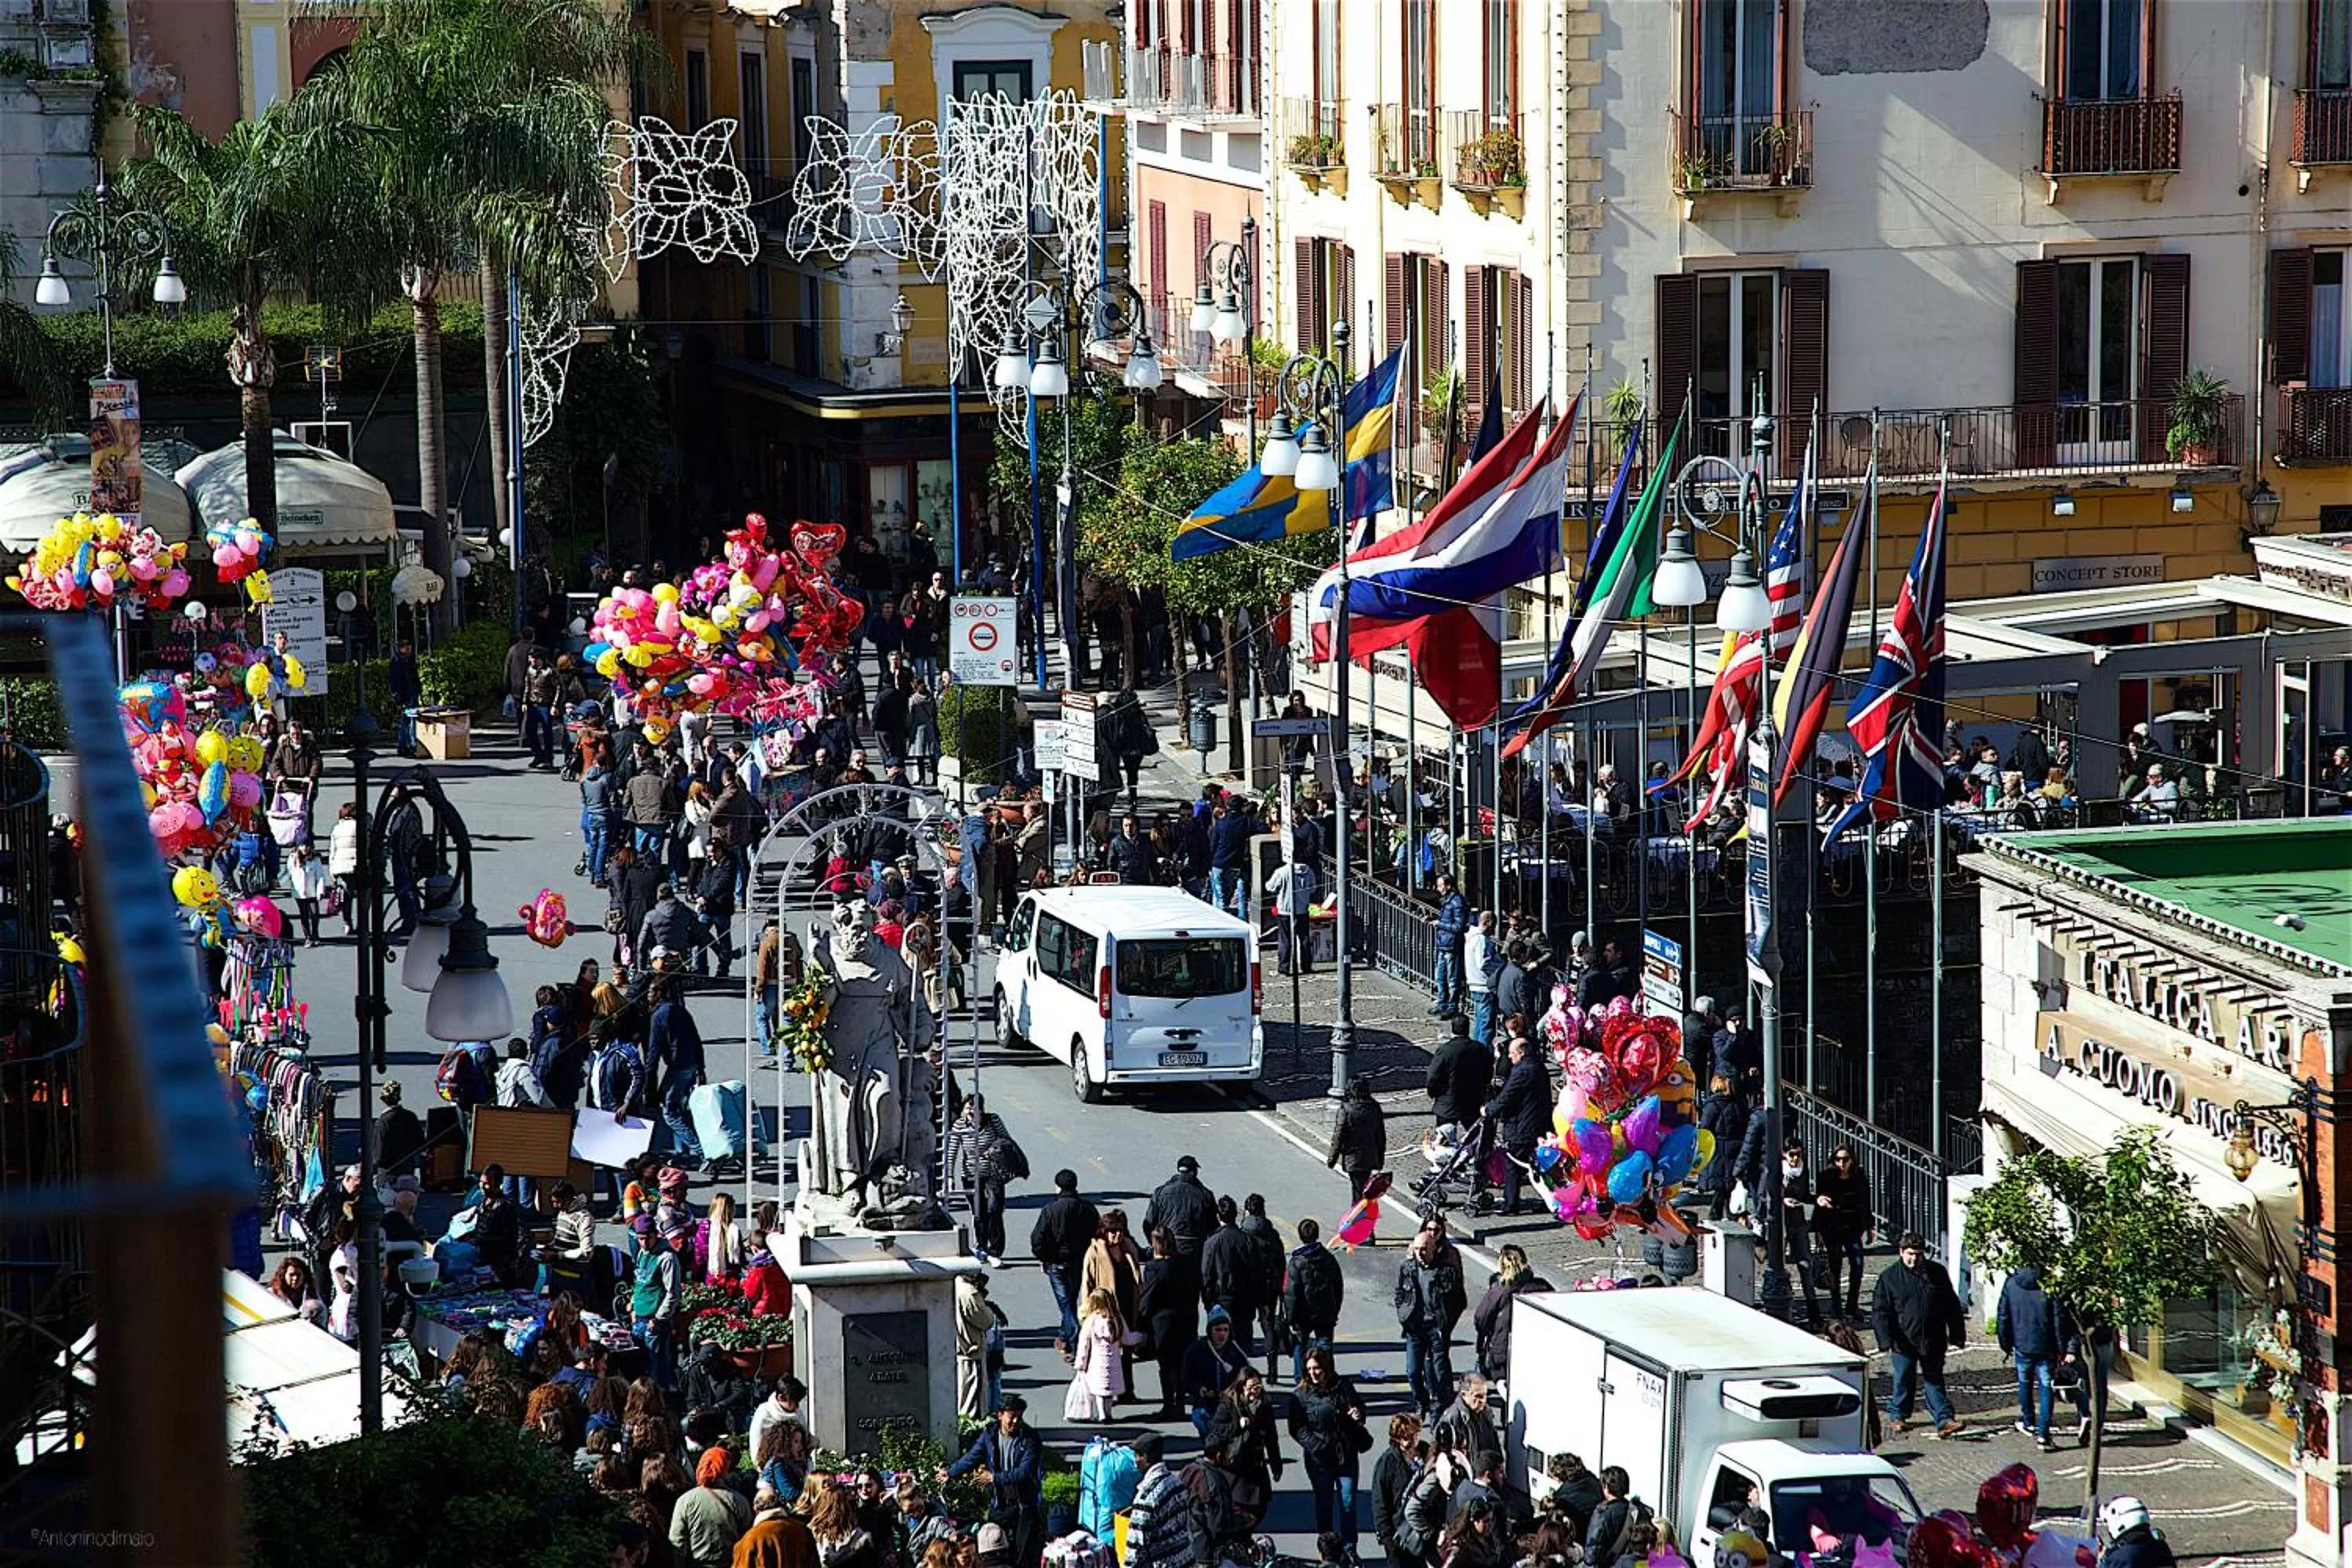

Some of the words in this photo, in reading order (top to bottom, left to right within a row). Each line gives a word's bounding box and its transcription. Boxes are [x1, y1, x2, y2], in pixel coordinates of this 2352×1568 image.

[2034, 566, 2107, 583] CONCEPT
[2113, 564, 2161, 579] STORE
[2079, 949, 2220, 1045] ITALICA
[2080, 1038, 2177, 1111] CUOMO
[2254, 1126, 2294, 1166] 1856
